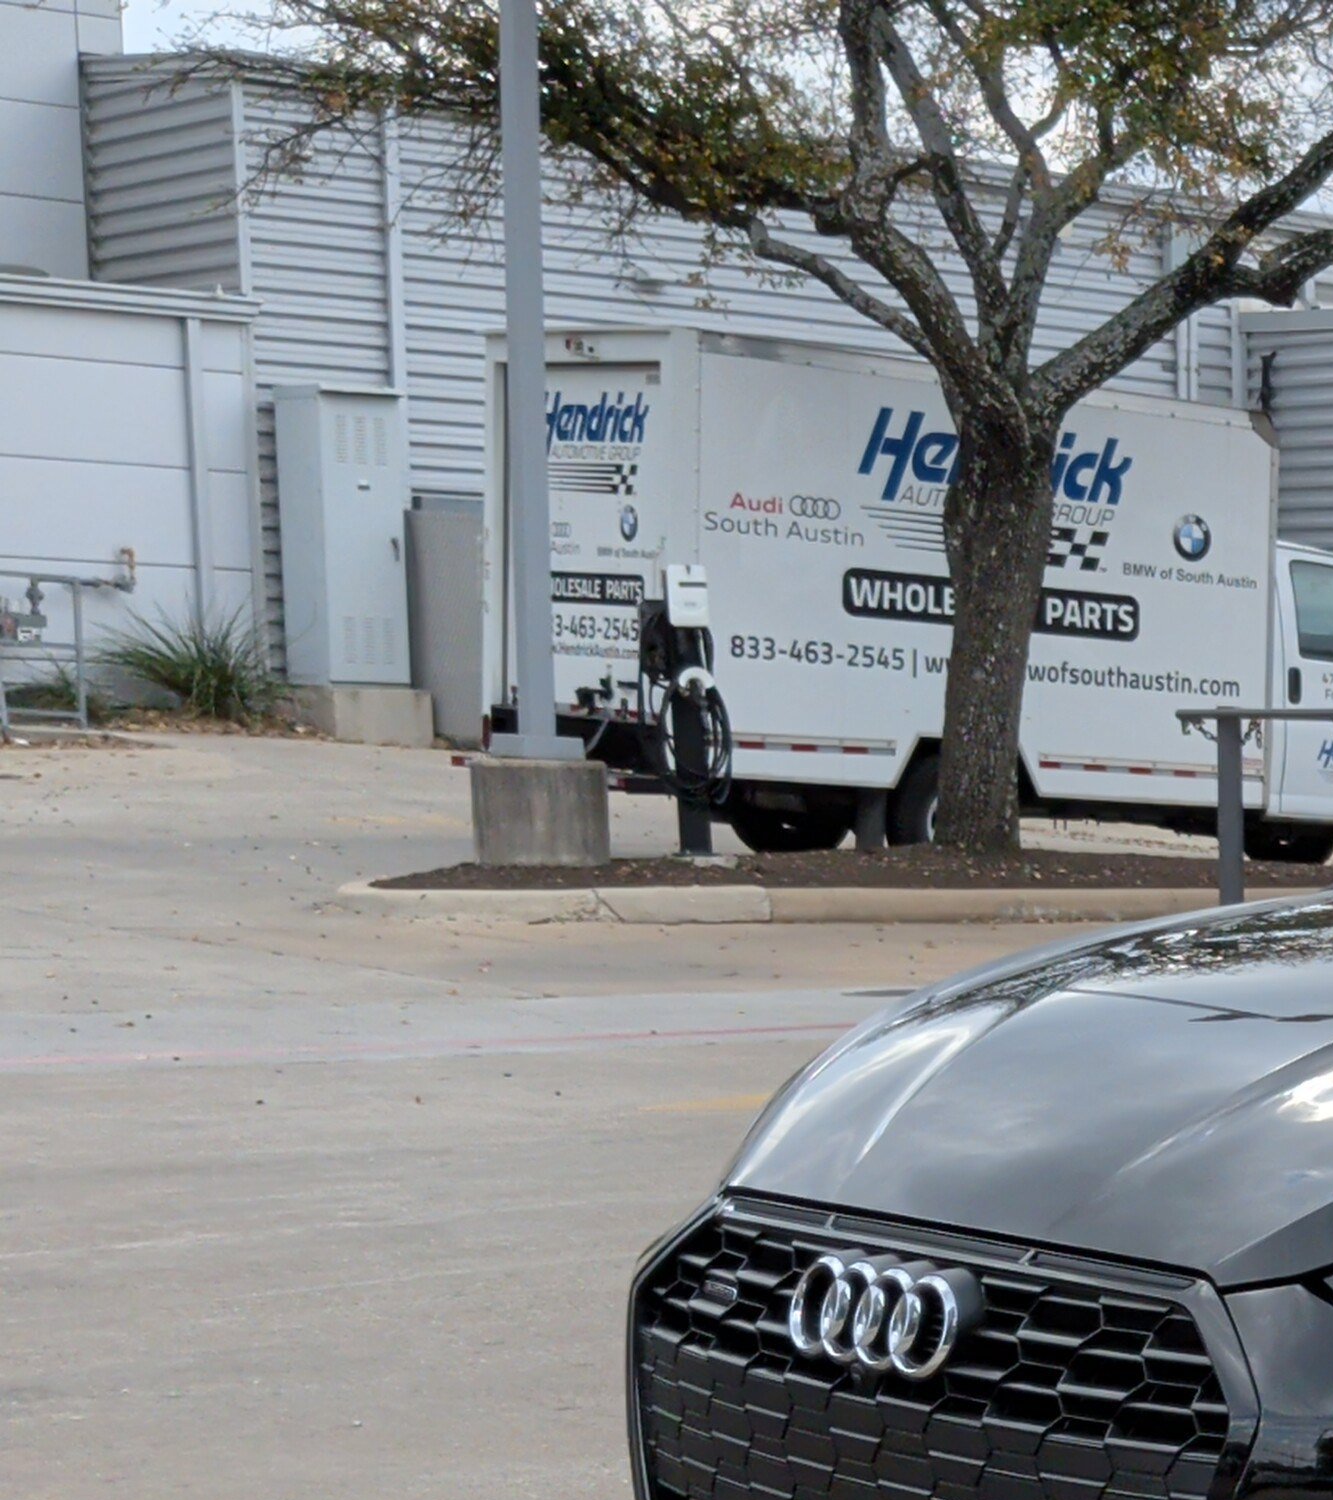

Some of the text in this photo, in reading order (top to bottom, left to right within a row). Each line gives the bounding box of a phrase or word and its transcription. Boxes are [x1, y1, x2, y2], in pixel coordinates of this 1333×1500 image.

[858, 407, 1133, 506] Heick
[730, 492, 783, 514] Audi
[704, 511, 865, 547] South Austin
[553, 578, 642, 602] OLESALE PARTS
[1123, 562, 1257, 589] BMW of South Austin
[850, 577, 1135, 633] WHOLE PARTS
[555, 614, 640, 642] 3-463-2545
[731, 635, 905, 670] 833-463-2545
